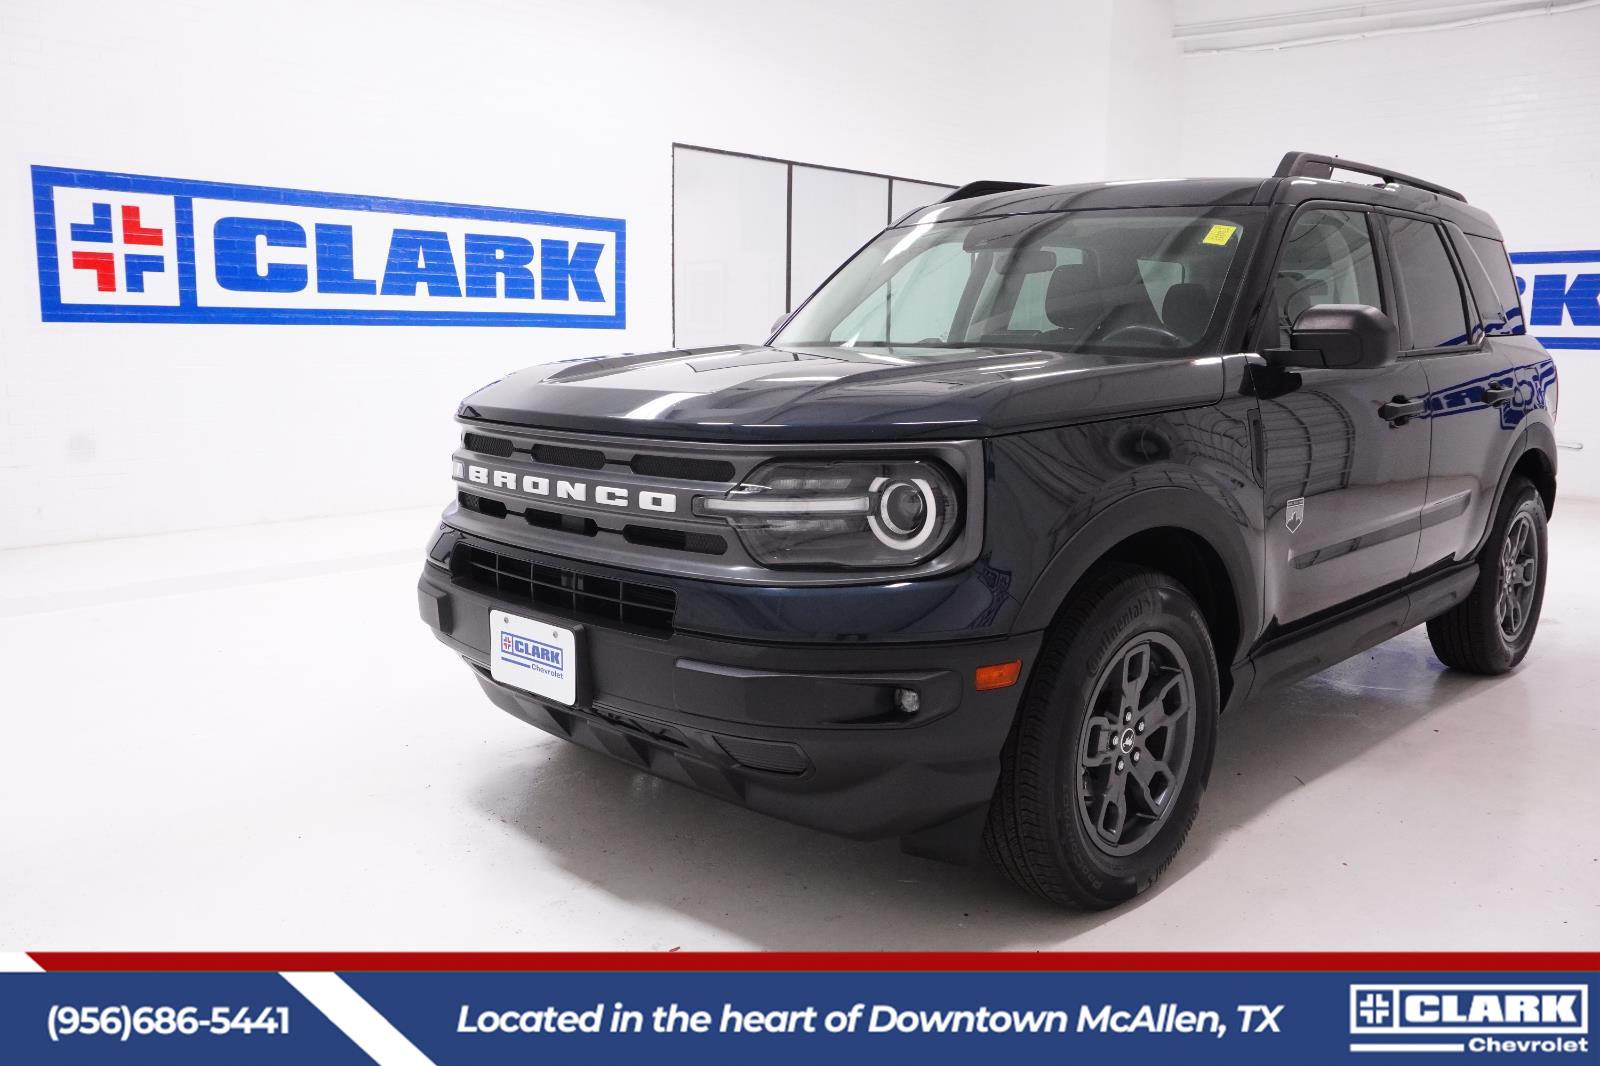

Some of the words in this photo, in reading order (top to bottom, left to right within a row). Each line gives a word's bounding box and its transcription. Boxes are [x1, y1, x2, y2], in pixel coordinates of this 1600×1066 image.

[213, 216, 607, 302] CLARK
[1515, 274, 1600, 326] K
[469, 466, 677, 513] BRONCO
[515, 640, 561, 665] CLARK
[532, 664, 564, 680] Chevrolet
